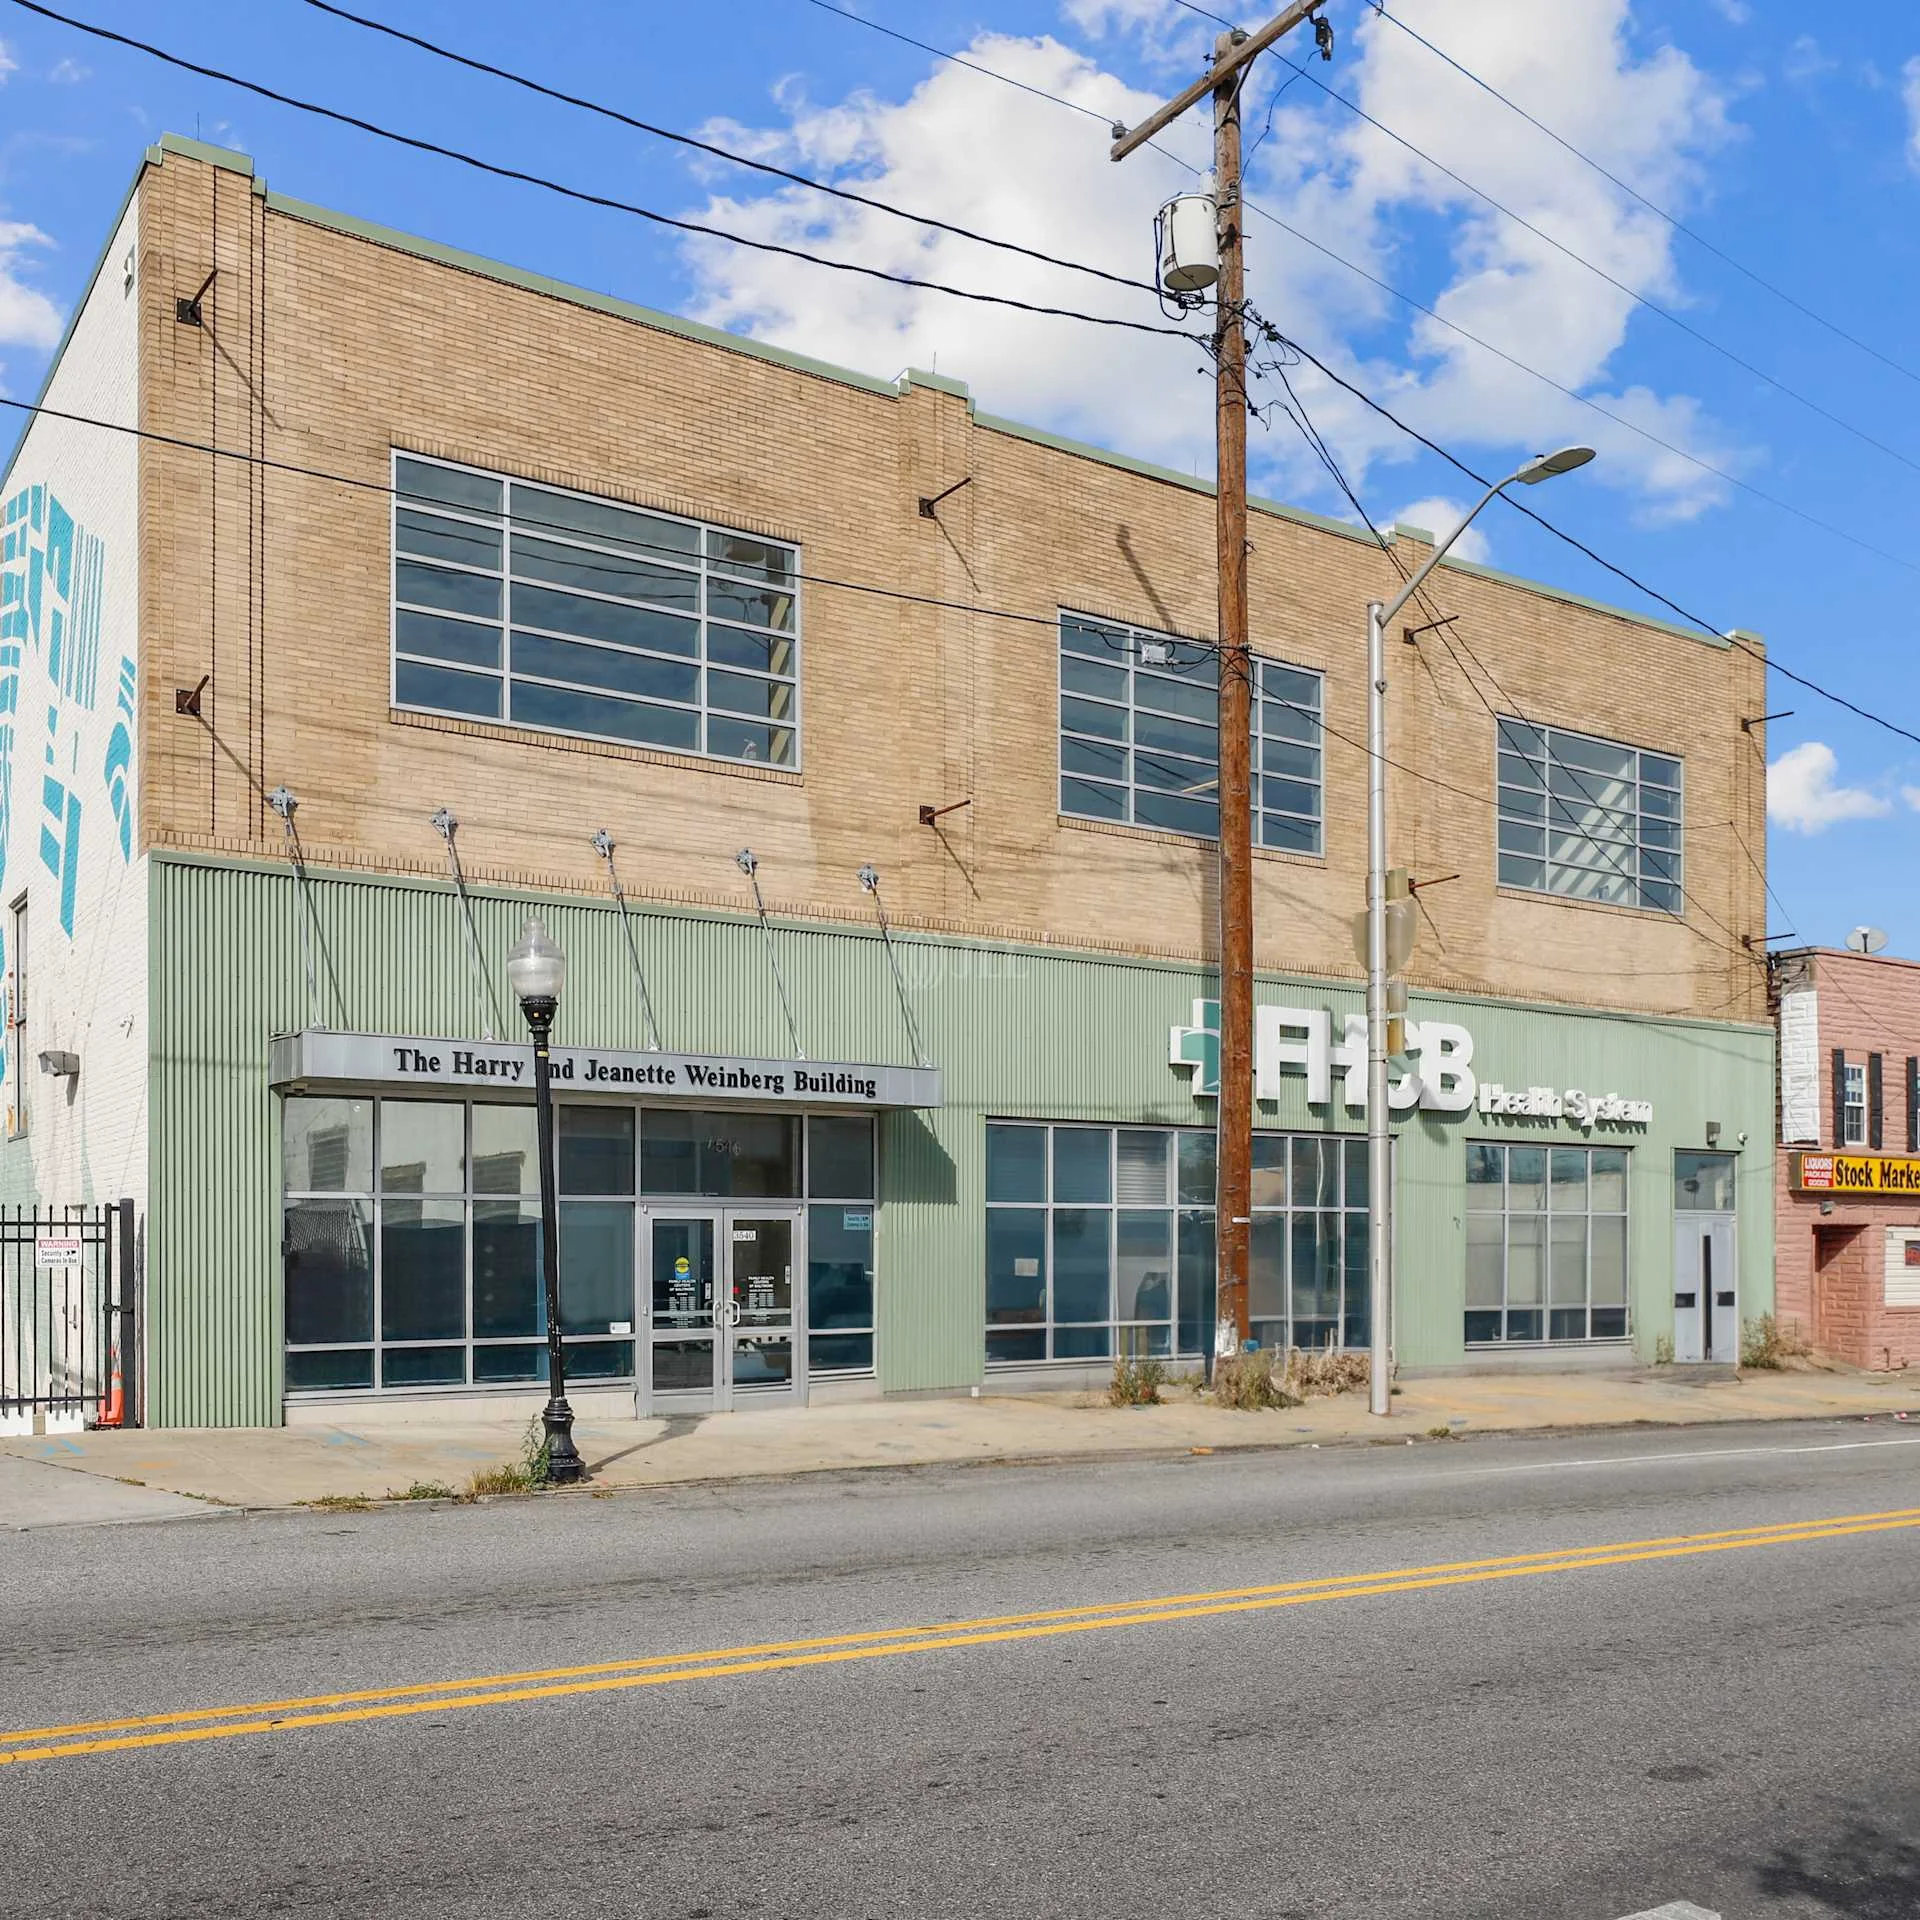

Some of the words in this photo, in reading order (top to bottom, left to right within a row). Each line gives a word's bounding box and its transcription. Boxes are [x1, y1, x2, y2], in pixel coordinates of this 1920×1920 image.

[393, 1048, 441, 1073] The
[453, 1051, 525, 1080] Harry
[538, 1058, 574, 1080] nd
[584, 1059, 675, 1084] Jeanette
[685, 1064, 784, 1094] Weinberg
[793, 1070, 877, 1097] Building
[1479, 1083, 1562, 1117] Health
[1563, 1089, 1653, 1126] System
[1835, 1159, 1873, 1187] Stock
[1879, 1160, 1920, 1189] Marke
[39, 1240, 78, 1248] WARNING
[41, 1249, 62, 1257] Security
